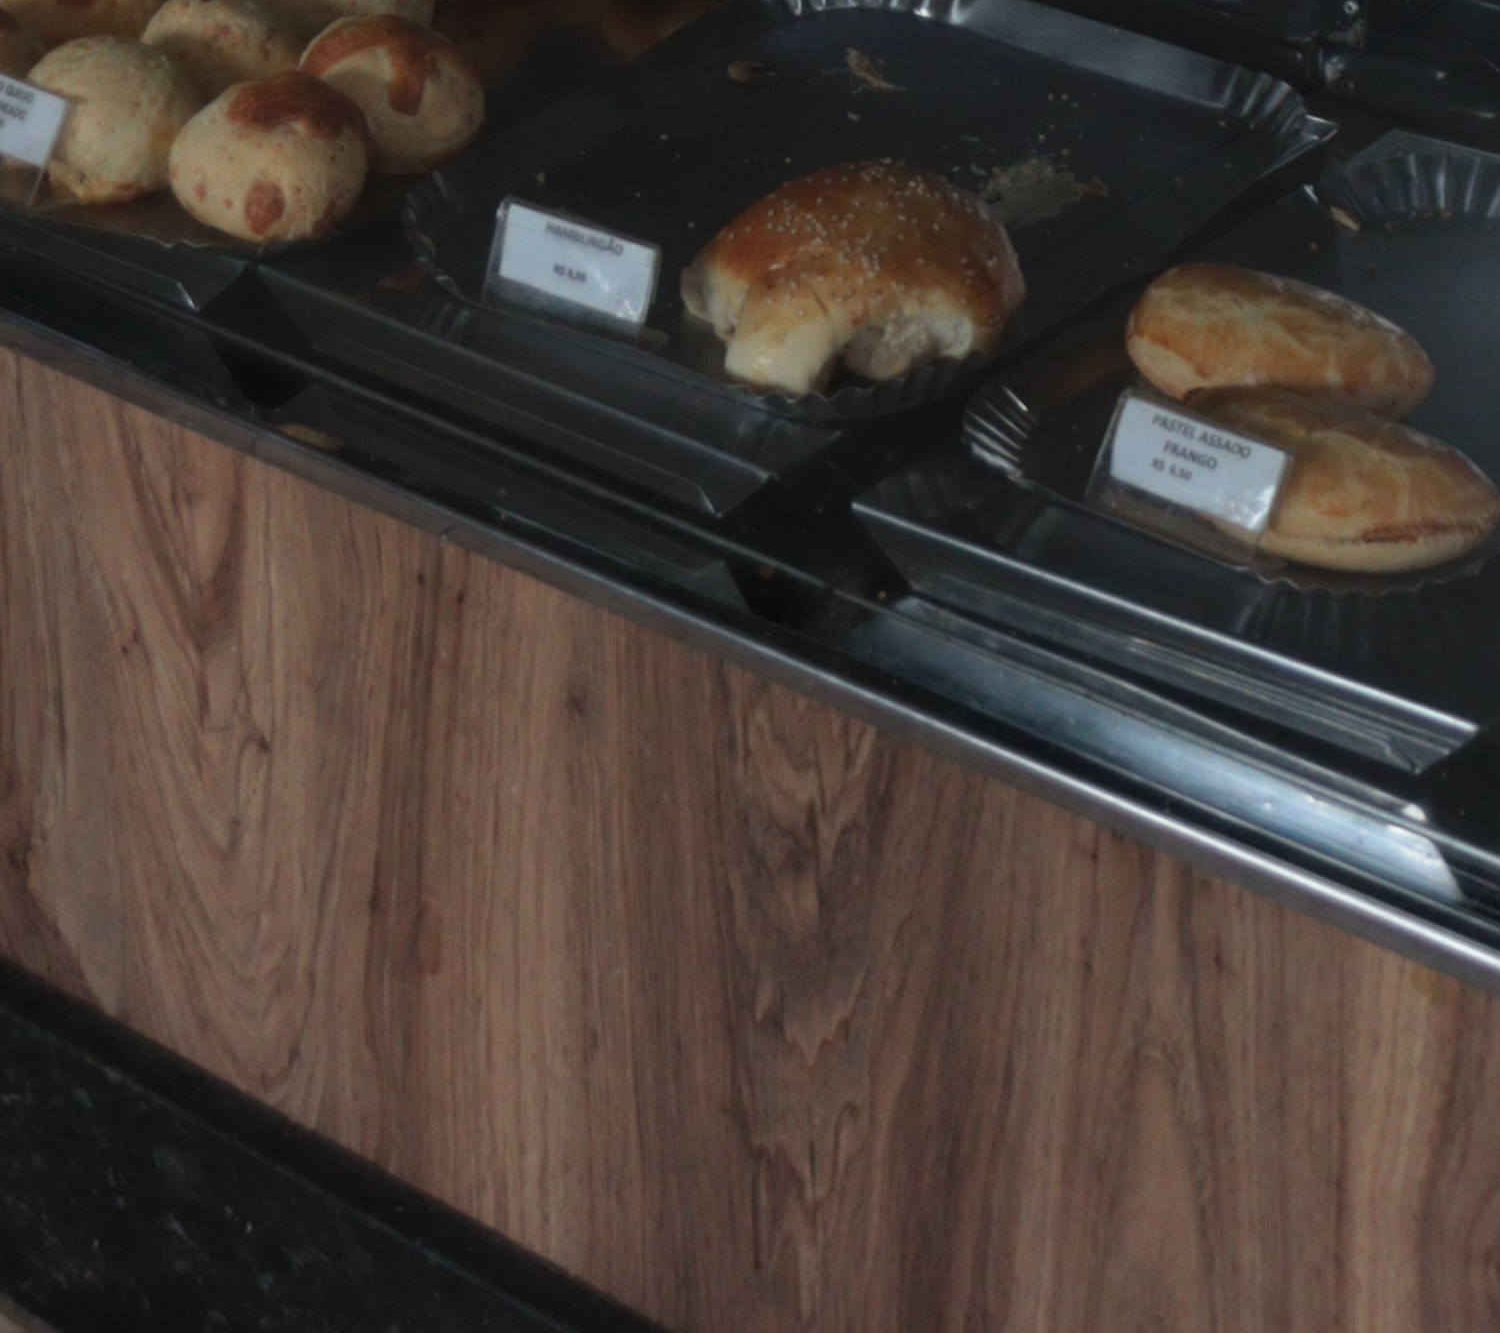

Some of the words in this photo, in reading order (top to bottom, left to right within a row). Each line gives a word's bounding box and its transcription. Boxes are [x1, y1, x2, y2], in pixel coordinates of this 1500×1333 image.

[6, 84, 34, 104] QUEIJO
[546, 221, 624, 257] HAMBURGÃO
[554, 264, 565, 276] R$
[1152, 414, 1197, 438] PASTEL
[1199, 429, 1251, 459] ASSADO
[1152, 458, 1165, 472] R$
[1164, 441, 1218, 470] FRANGO
